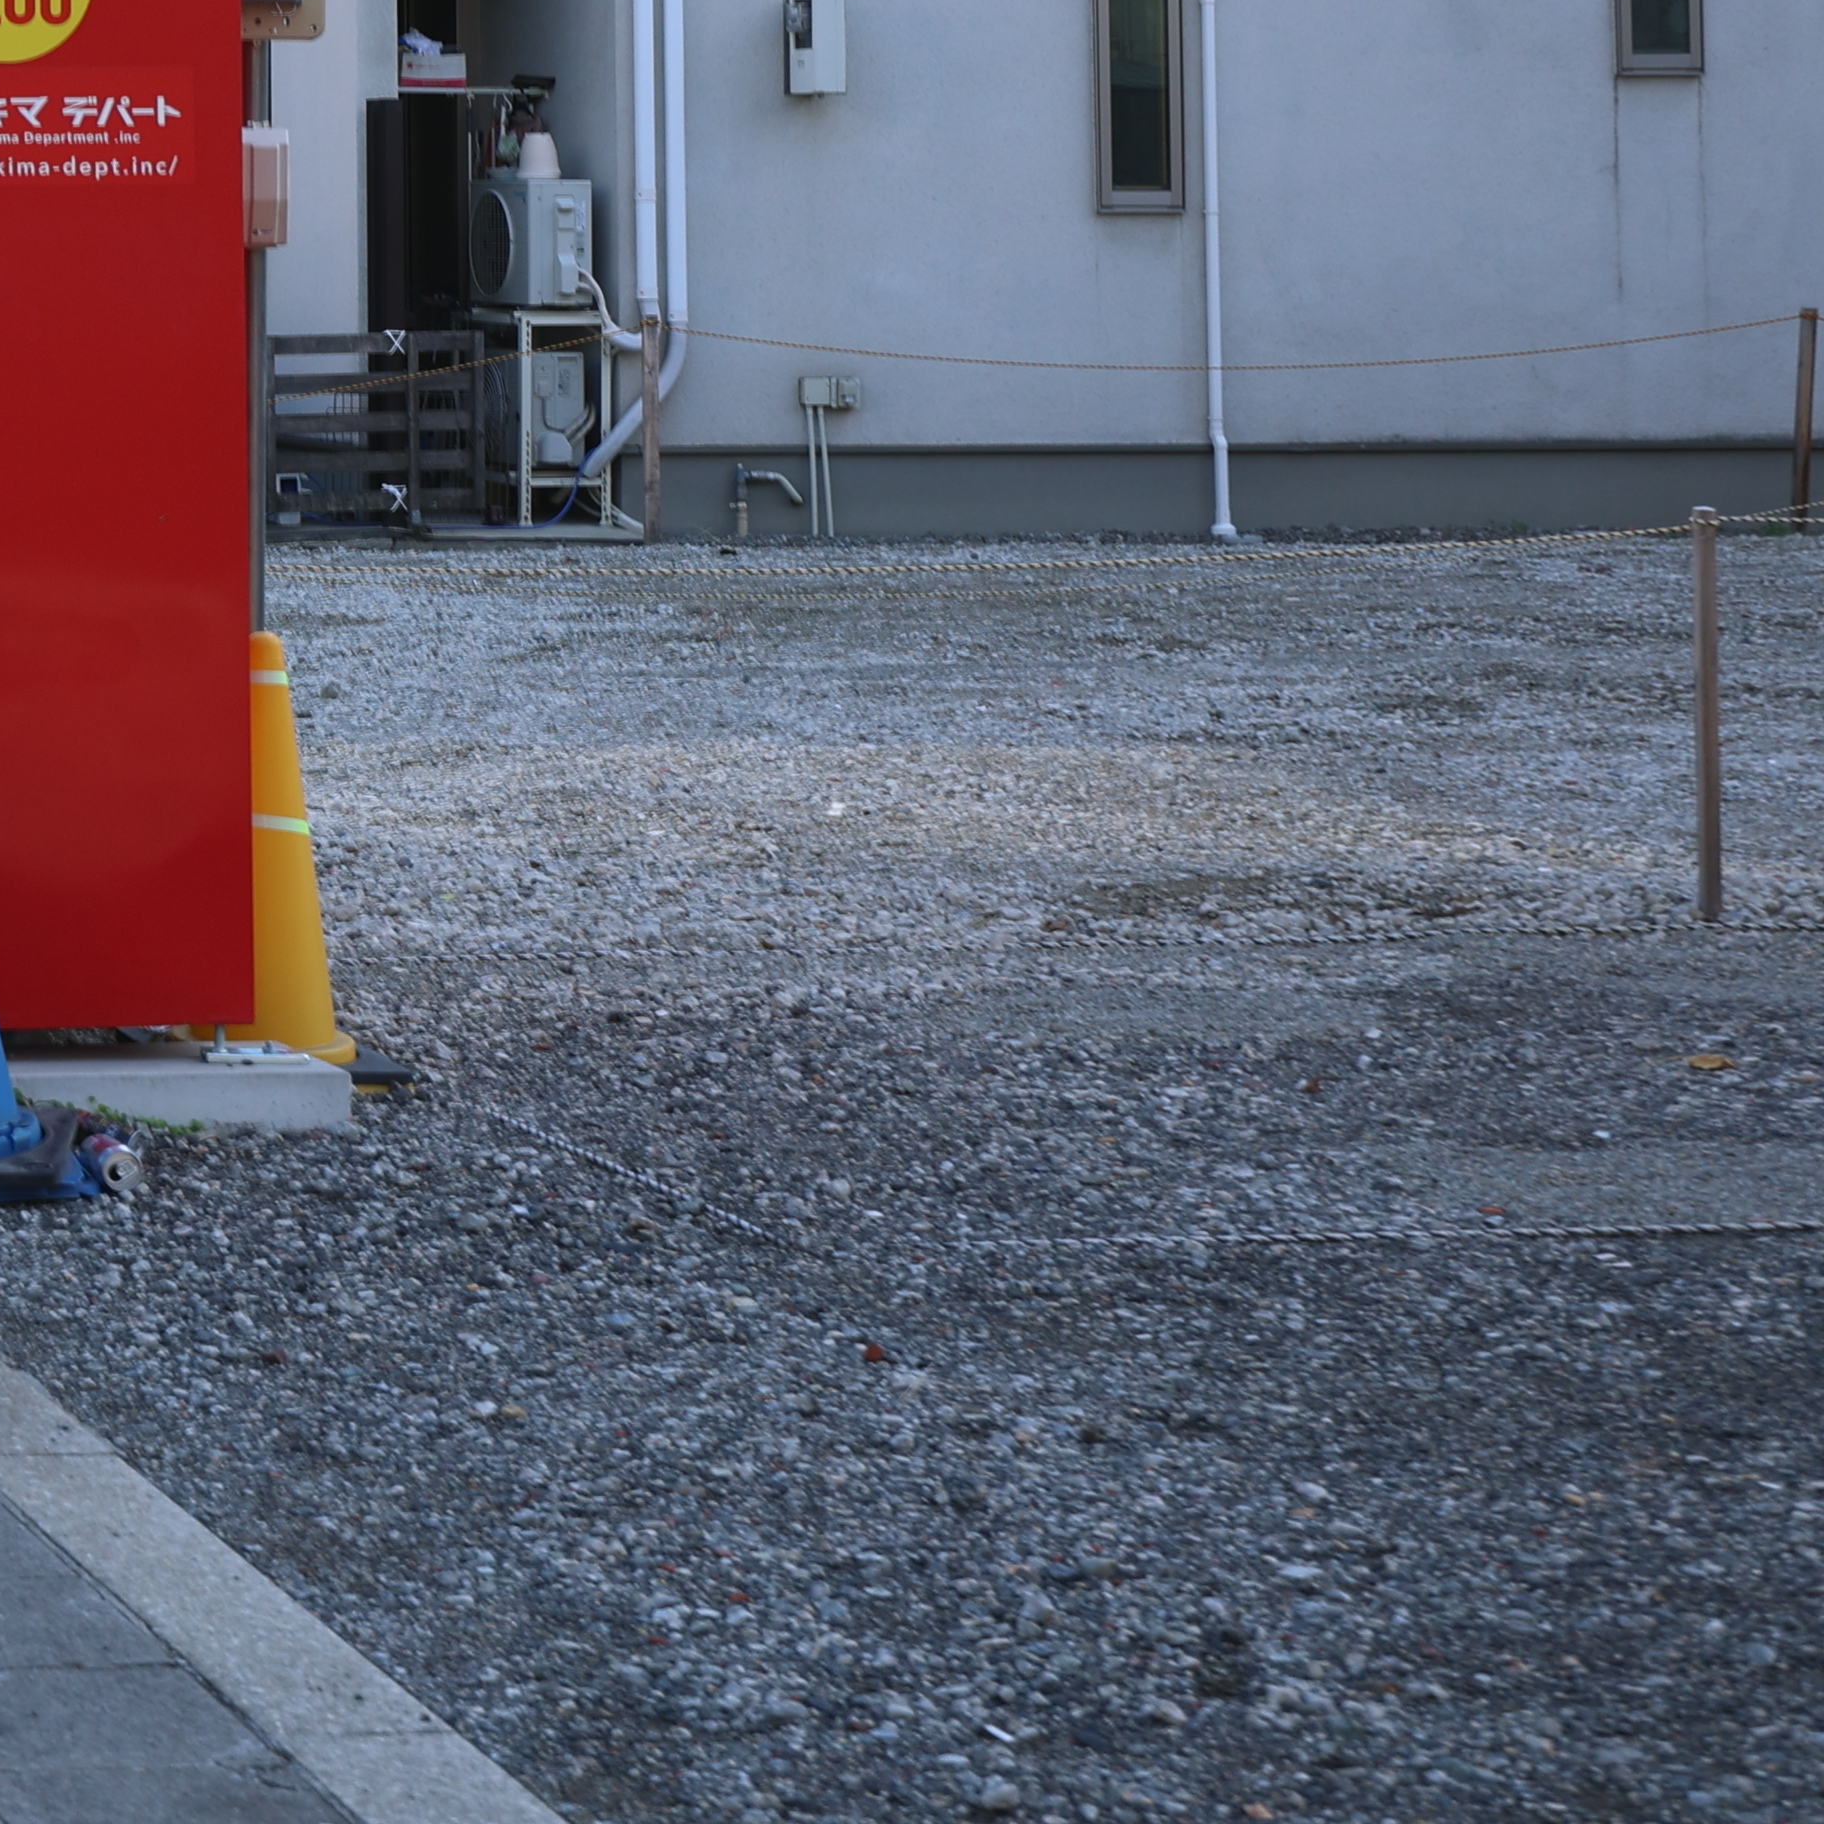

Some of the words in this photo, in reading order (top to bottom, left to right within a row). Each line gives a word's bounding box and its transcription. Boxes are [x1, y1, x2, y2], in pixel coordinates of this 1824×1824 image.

[62, 95, 181, 127] デパート
[24, 131, 109, 147] Department
